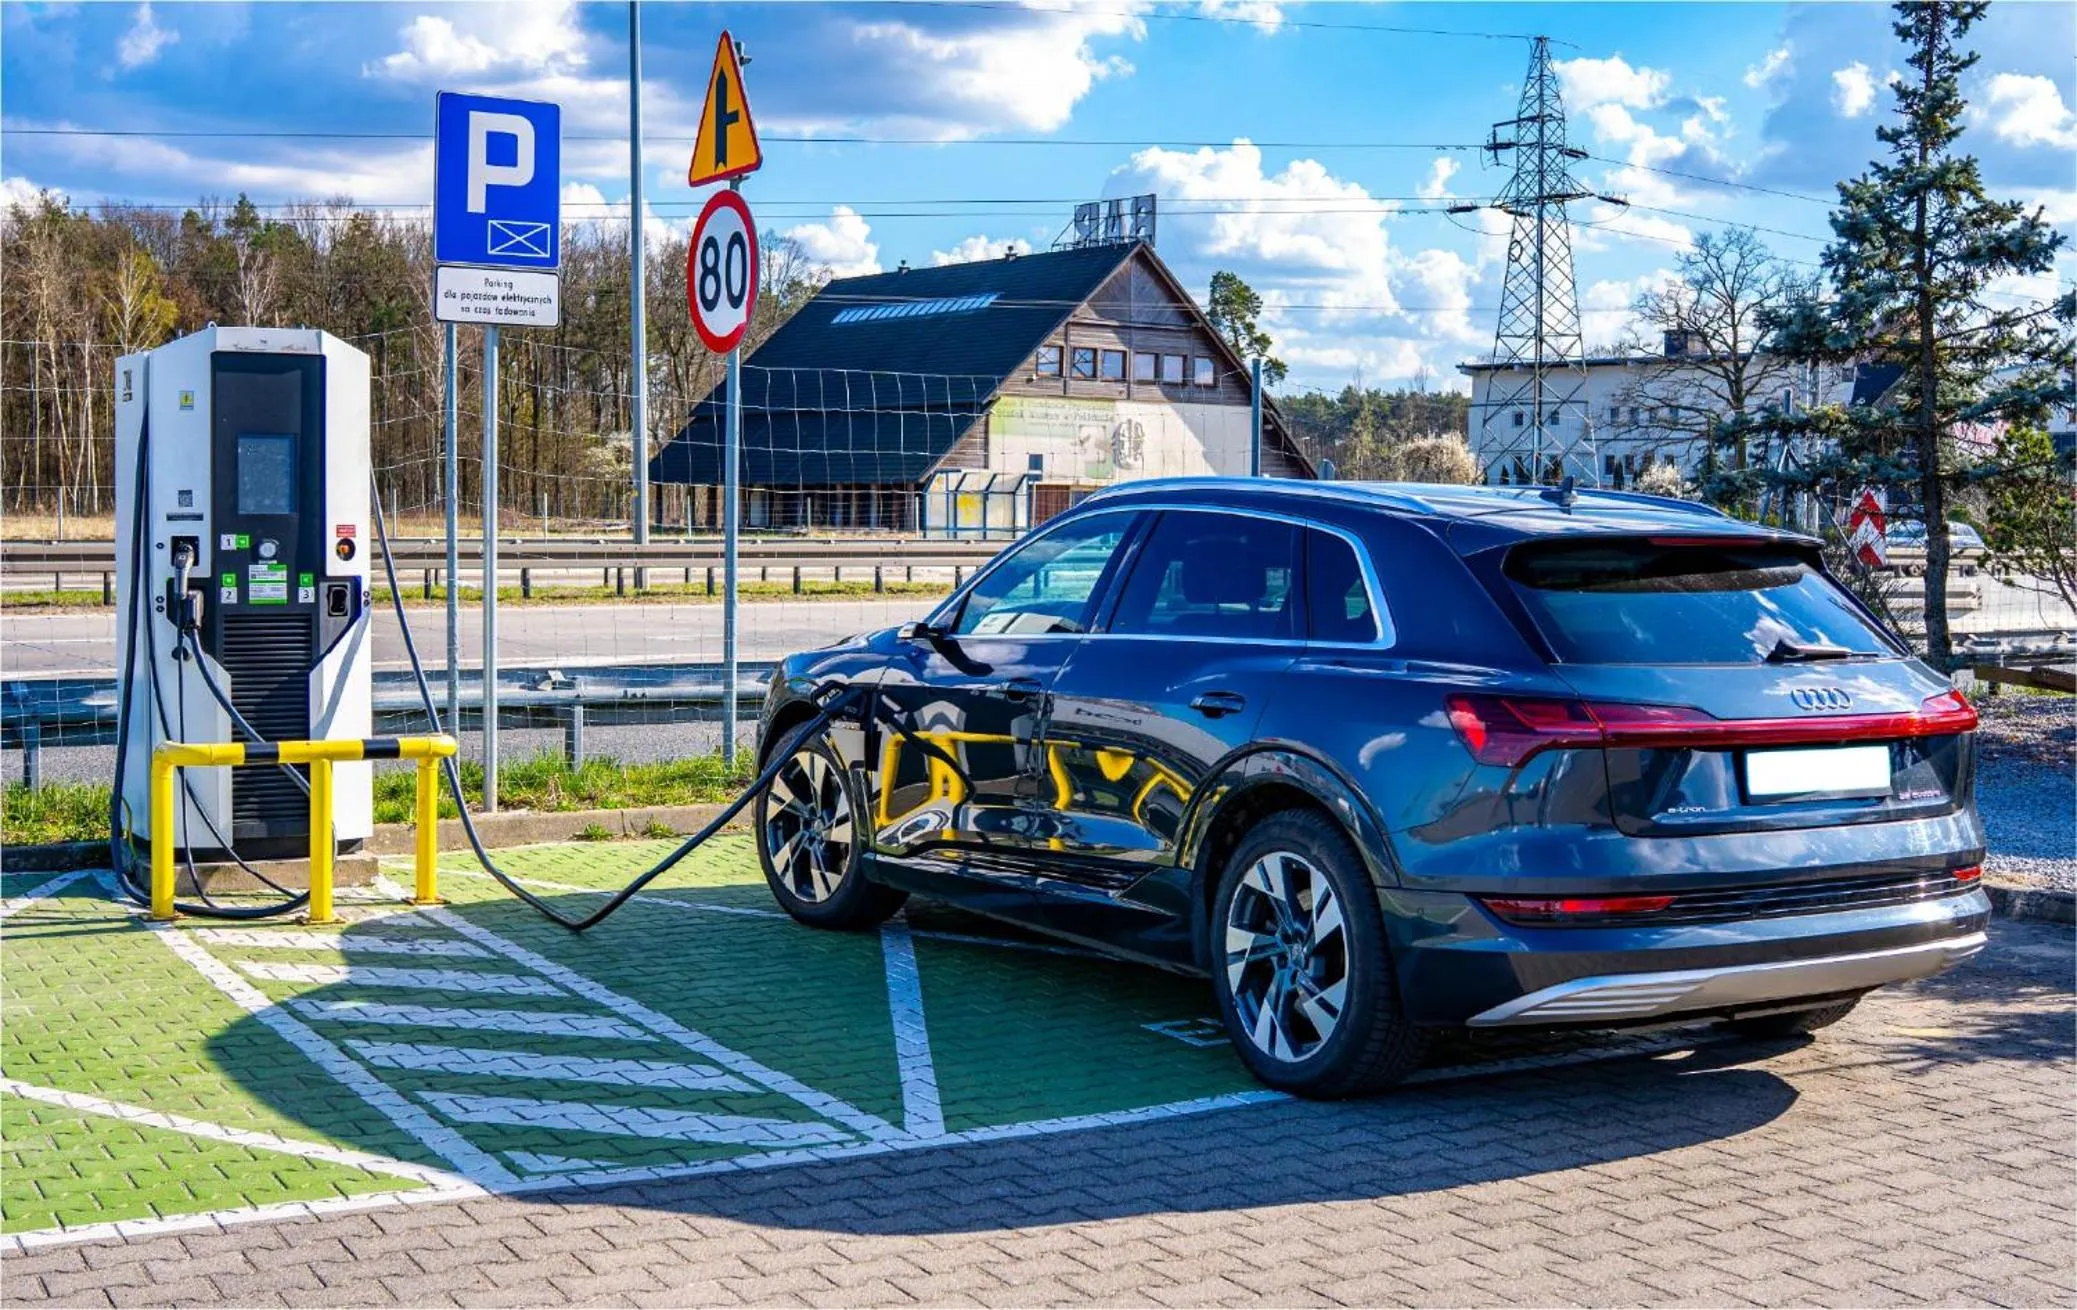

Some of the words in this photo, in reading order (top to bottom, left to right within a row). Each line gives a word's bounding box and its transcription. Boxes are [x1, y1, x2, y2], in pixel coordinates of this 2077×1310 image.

[467, 111, 535, 214] P
[699, 231, 747, 312] 80
[484, 278, 513, 291] Parking
[444, 289, 456, 299] dla
[501, 292, 552, 305] elektrycznych
[461, 305, 470, 313] na
[474, 305, 491, 315] czas
[303, 589, 310, 599] 3
